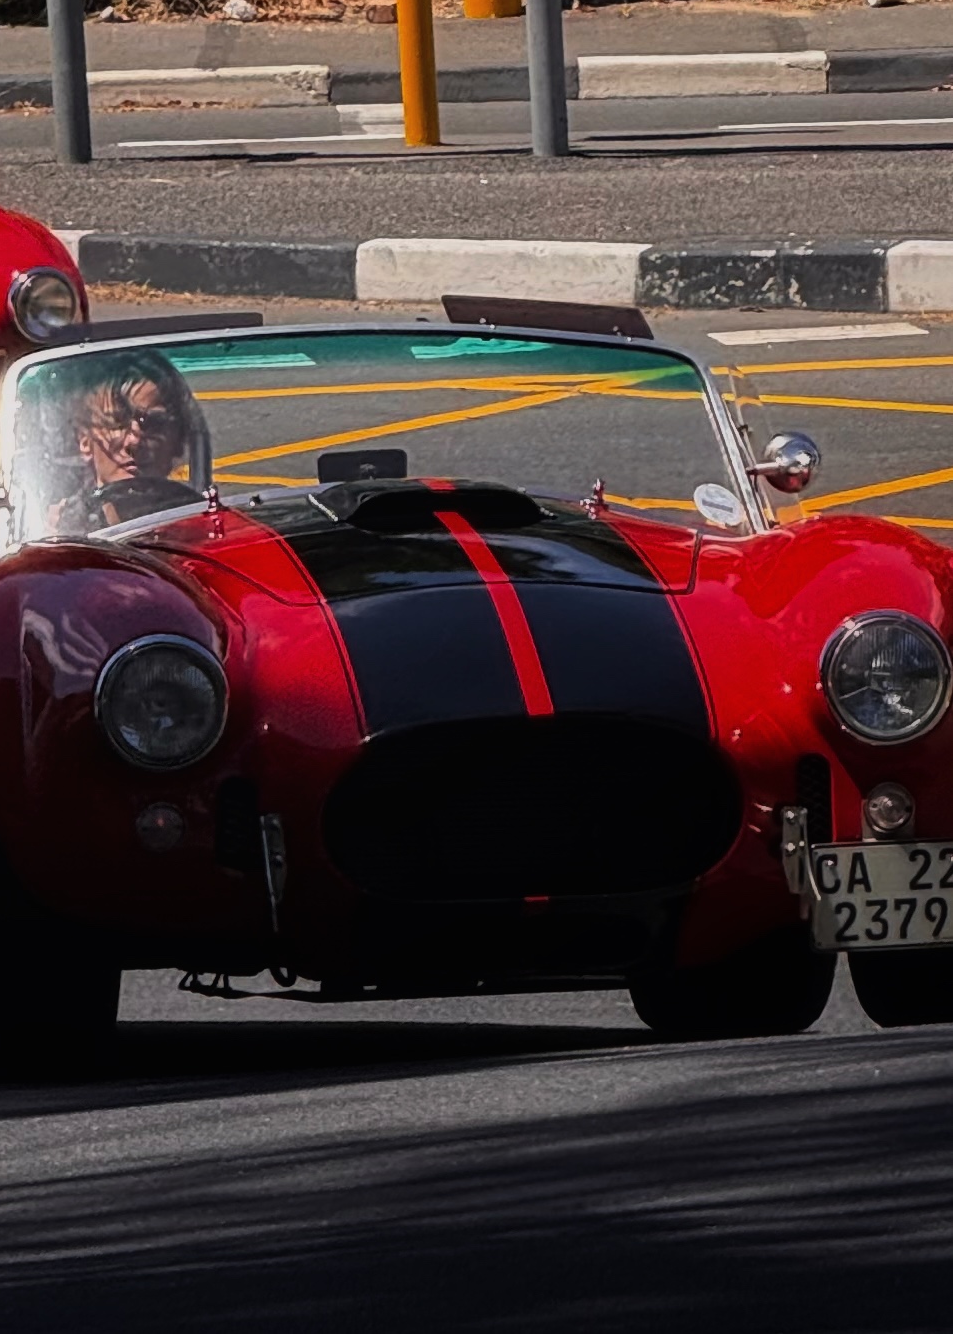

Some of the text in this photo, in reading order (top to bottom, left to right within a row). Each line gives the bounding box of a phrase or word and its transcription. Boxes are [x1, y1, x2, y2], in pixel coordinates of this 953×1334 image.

[815, 847, 953, 895] CA 22
[834, 896, 948, 942] 2379
